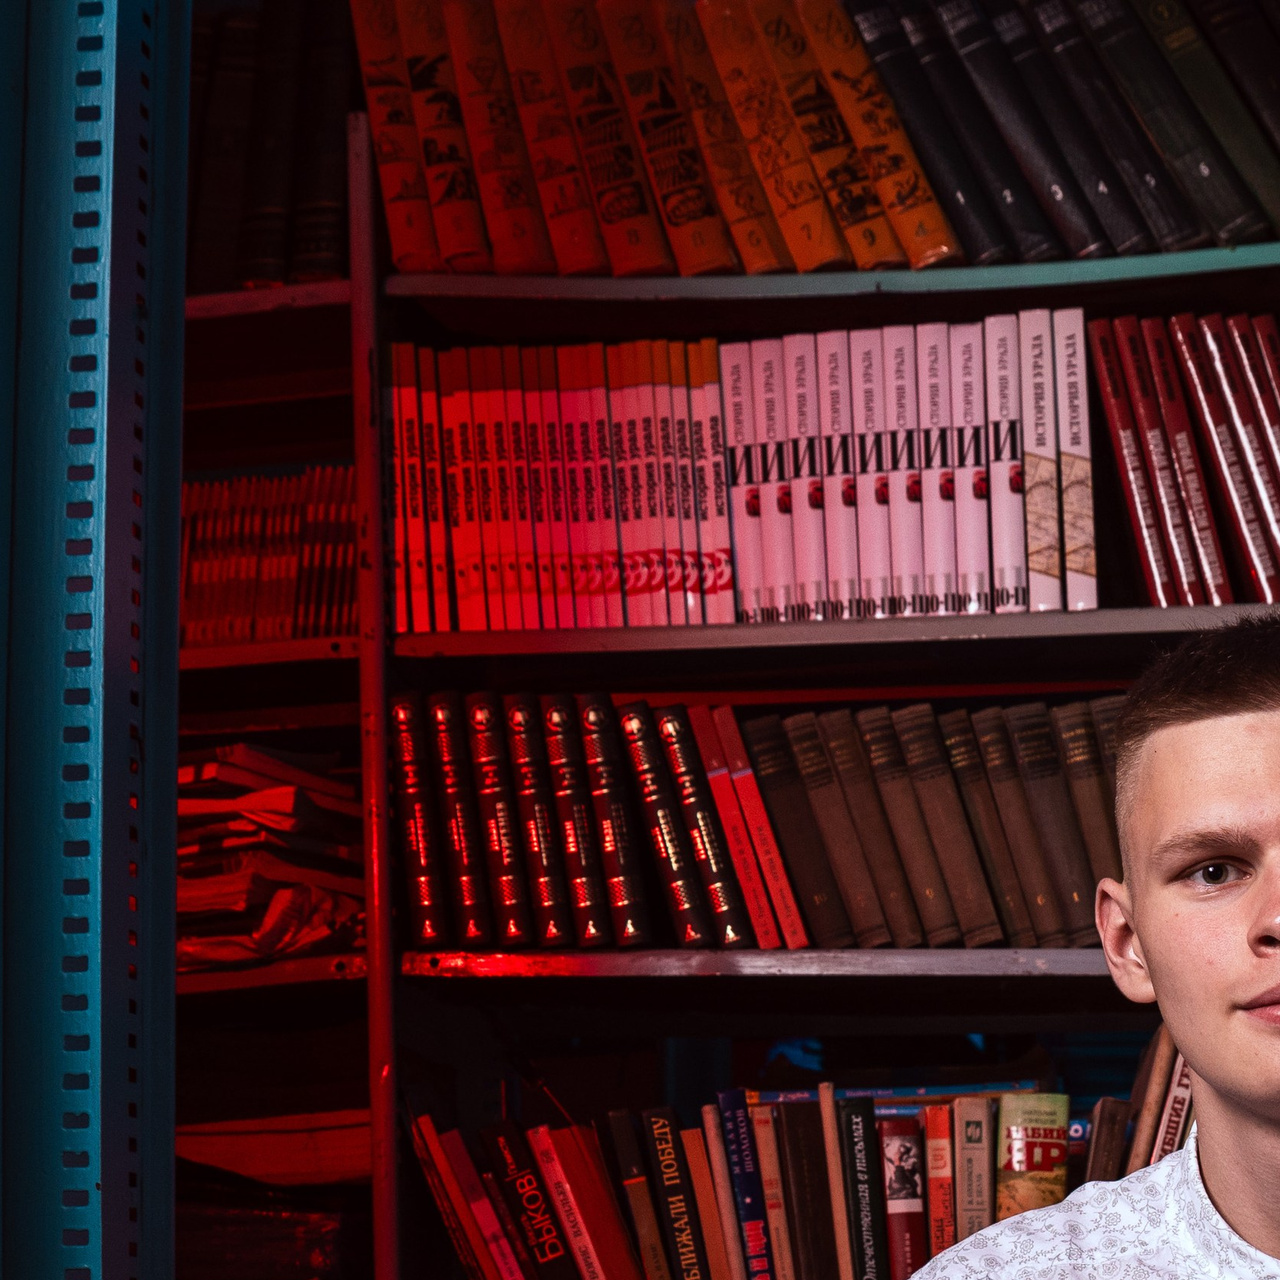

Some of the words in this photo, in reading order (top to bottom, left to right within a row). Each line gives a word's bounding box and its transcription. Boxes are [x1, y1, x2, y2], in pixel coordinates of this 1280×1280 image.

[794, 355, 806, 389] УРАЛА
[828, 352, 840, 386] УРАЛА
[862, 350, 872, 383] УРАЛА
[894, 346, 905, 380] УРАЛА
[928, 344, 938, 379] УРАЛА
[962, 343, 972, 376] УРАЛА
[996, 336, 1008, 370] УРАЛА
[1032, 334, 1044, 379] УРАЛА
[1066, 333, 1078, 377] УРАЛА
[731, 364, 740, 396] УРАЛА
[764, 360, 774, 394] УРАЛА
[1033, 381, 1046, 448] ИСТОРИЯ
[1067, 381, 1081, 446] ИСТОРИЯ
[424, 423, 436, 462] урала
[460, 422, 472, 461] урала
[494, 422, 508, 460] урала
[547, 422, 560, 461] урала
[580, 422, 593, 461] урала
[596, 419, 610, 458] урала
[628, 420, 641, 458] урала
[643, 416, 656, 456] урала
[661, 417, 674, 456] урала
[677, 419, 690, 458] урала
[710, 416, 724, 456] урала
[1176, 432, 1195, 472] УРАЛА
[1216, 424, 1238, 465] УРАЛА
[428, 468, 438, 522] история
[463, 467, 475, 521] история
[498, 466, 510, 521] история
[551, 467, 562, 522] история
[584, 467, 595, 522] история
[600, 463, 612, 520] история
[631, 464, 642, 520] история
[646, 462, 658, 517] история
[664, 462, 676, 517] история
[680, 464, 692, 520] история
[713, 461, 724, 516] история
[1186, 473, 1209, 529] ИСТОРИЯ
[1230, 466, 1256, 522] ИСТОРИЯ
[564, 821, 578, 852] Иван
[603, 820, 616, 852] Иван
[725, 1109, 741, 1174] МИХАИЛ
[735, 1108, 754, 1172] ШОЛОХОВ
[850, 1114, 868, 1171] письмах
[1005, 1126, 1067, 1140] БАБИЙ
[1157, 1095, 1188, 1159] ИБШИЕ
[496, 1135, 518, 1175] Повести
[652, 1117, 680, 1186] ПОБЕДУ
[1004, 1141, 1068, 1172] ЯР
[554, 1181, 582, 1238] ВАСИЛЬЕВ
[578, 1244, 598, 1280] БОРИС
